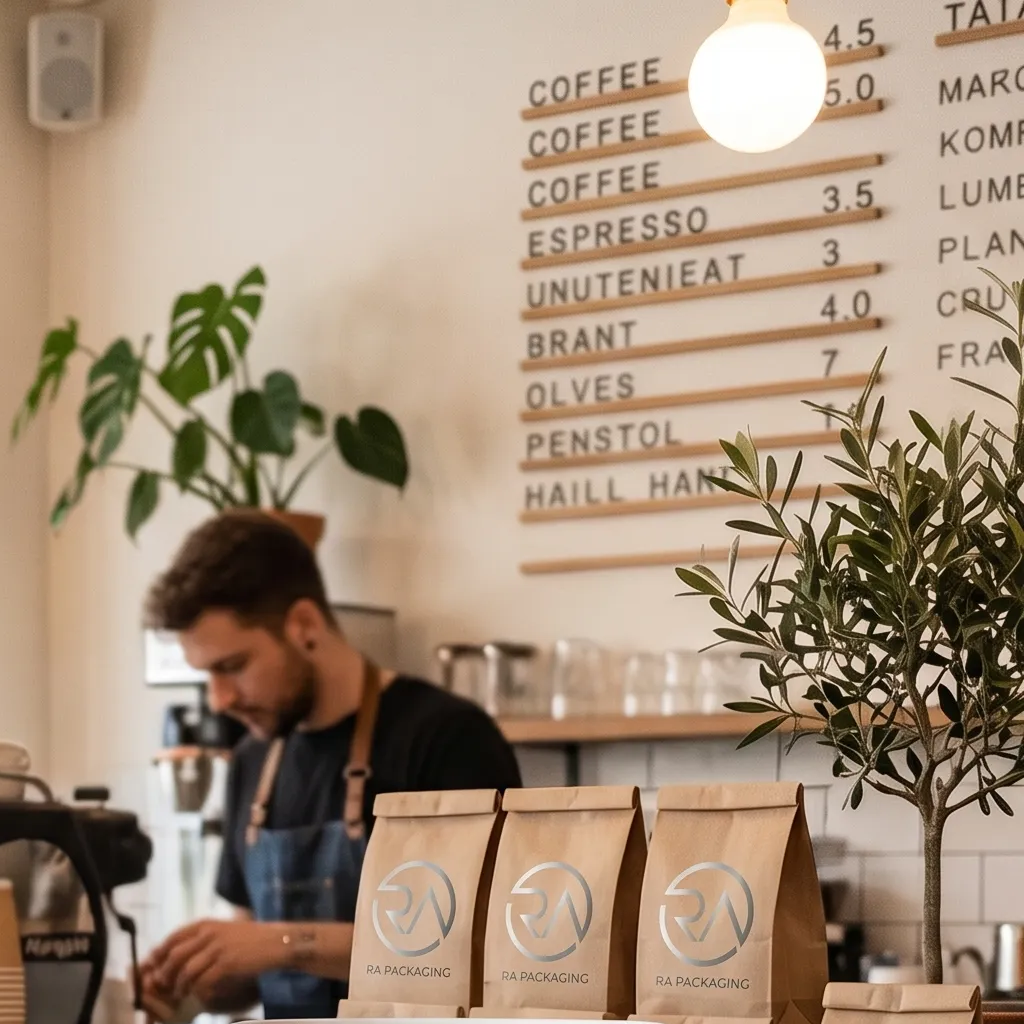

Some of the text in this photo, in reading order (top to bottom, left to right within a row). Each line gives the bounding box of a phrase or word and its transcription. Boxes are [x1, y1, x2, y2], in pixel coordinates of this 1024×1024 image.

[528, 18, 875, 108] COFFEE 4.5
[528, 72, 875, 158] COFFEE 5.0
[528, 161, 661, 208] COFFEE
[528, 180, 874, 259] ESPRESSO 3.5
[527, 239, 839, 309] UNUTENIEAT 3
[528, 289, 872, 359] BRANT 4.0
[526, 349, 839, 411] OLVES 7
[527, 421, 683, 459] PENSTOL
[526, 474, 624, 509] HAILL
[366, 964, 451, 978] RA PACKAGING
[502, 971, 589, 984] RA PACKAGING
[656, 975, 750, 990] RA PACKAGING
